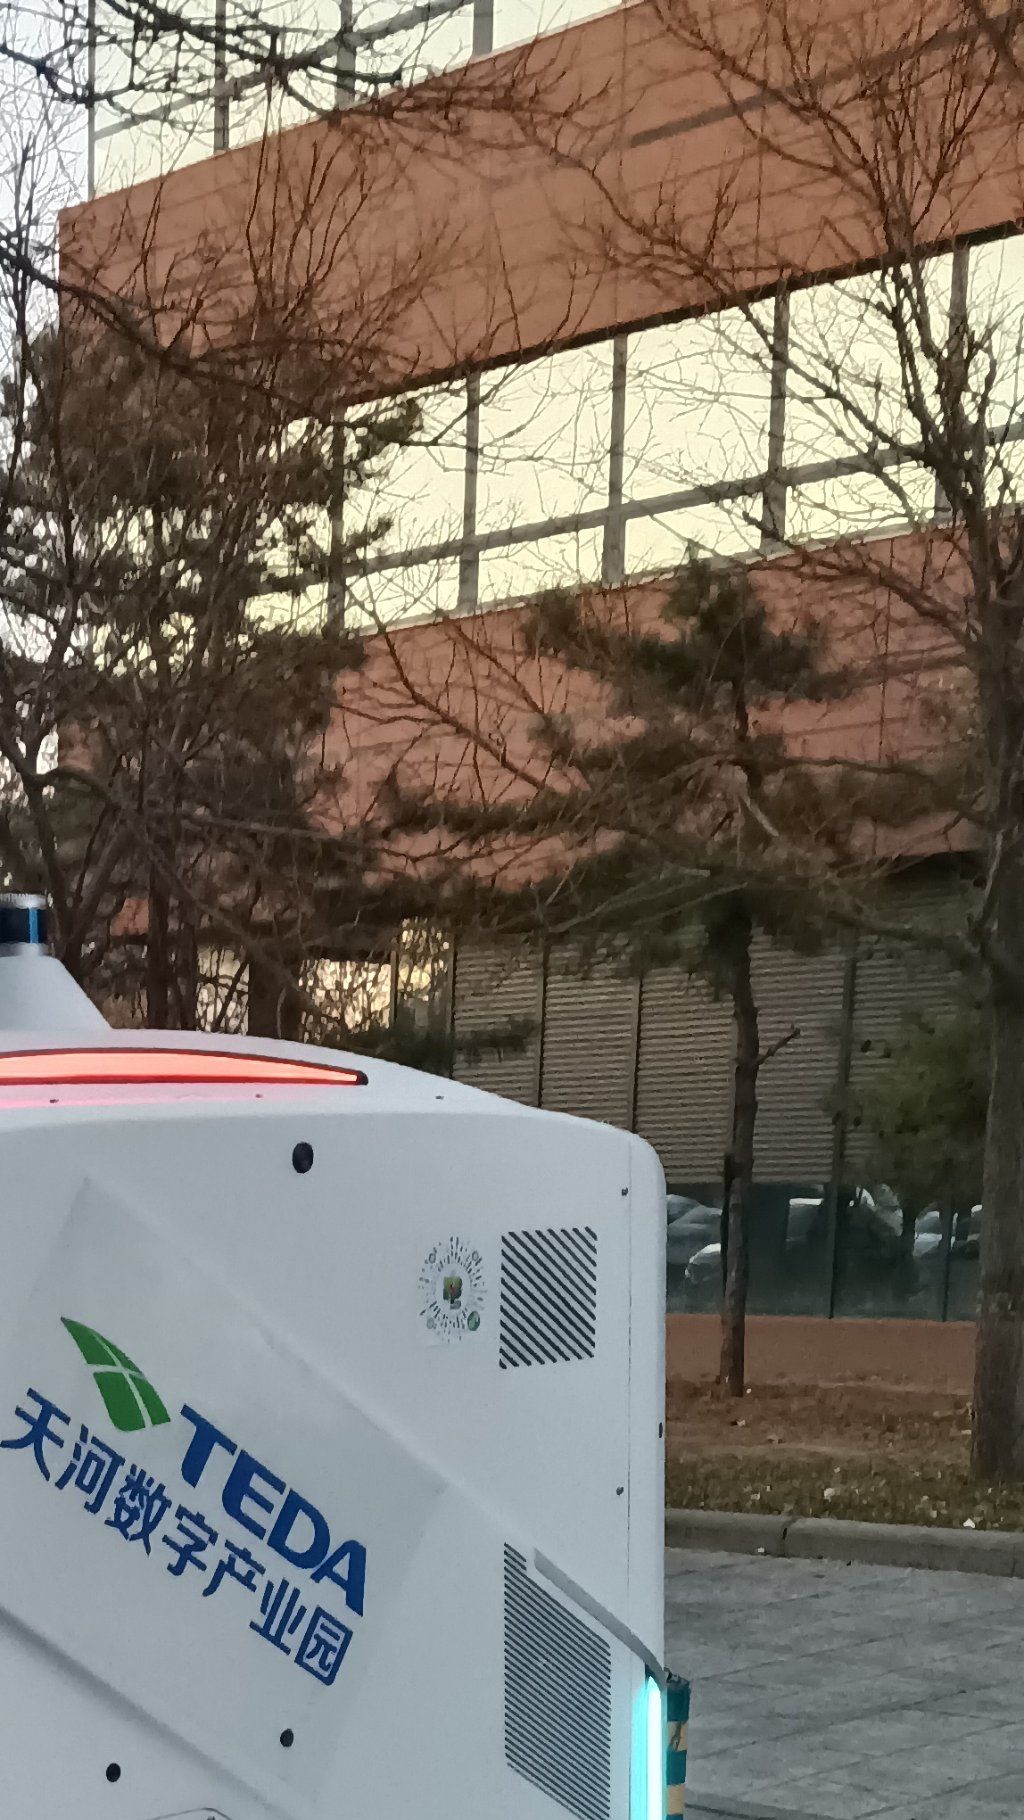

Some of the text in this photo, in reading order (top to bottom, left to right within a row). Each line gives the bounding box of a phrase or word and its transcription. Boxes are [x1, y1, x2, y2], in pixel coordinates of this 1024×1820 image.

[0, 1387, 354, 1686] 天河数字产业园
[180, 1404, 367, 1617] TEDA
